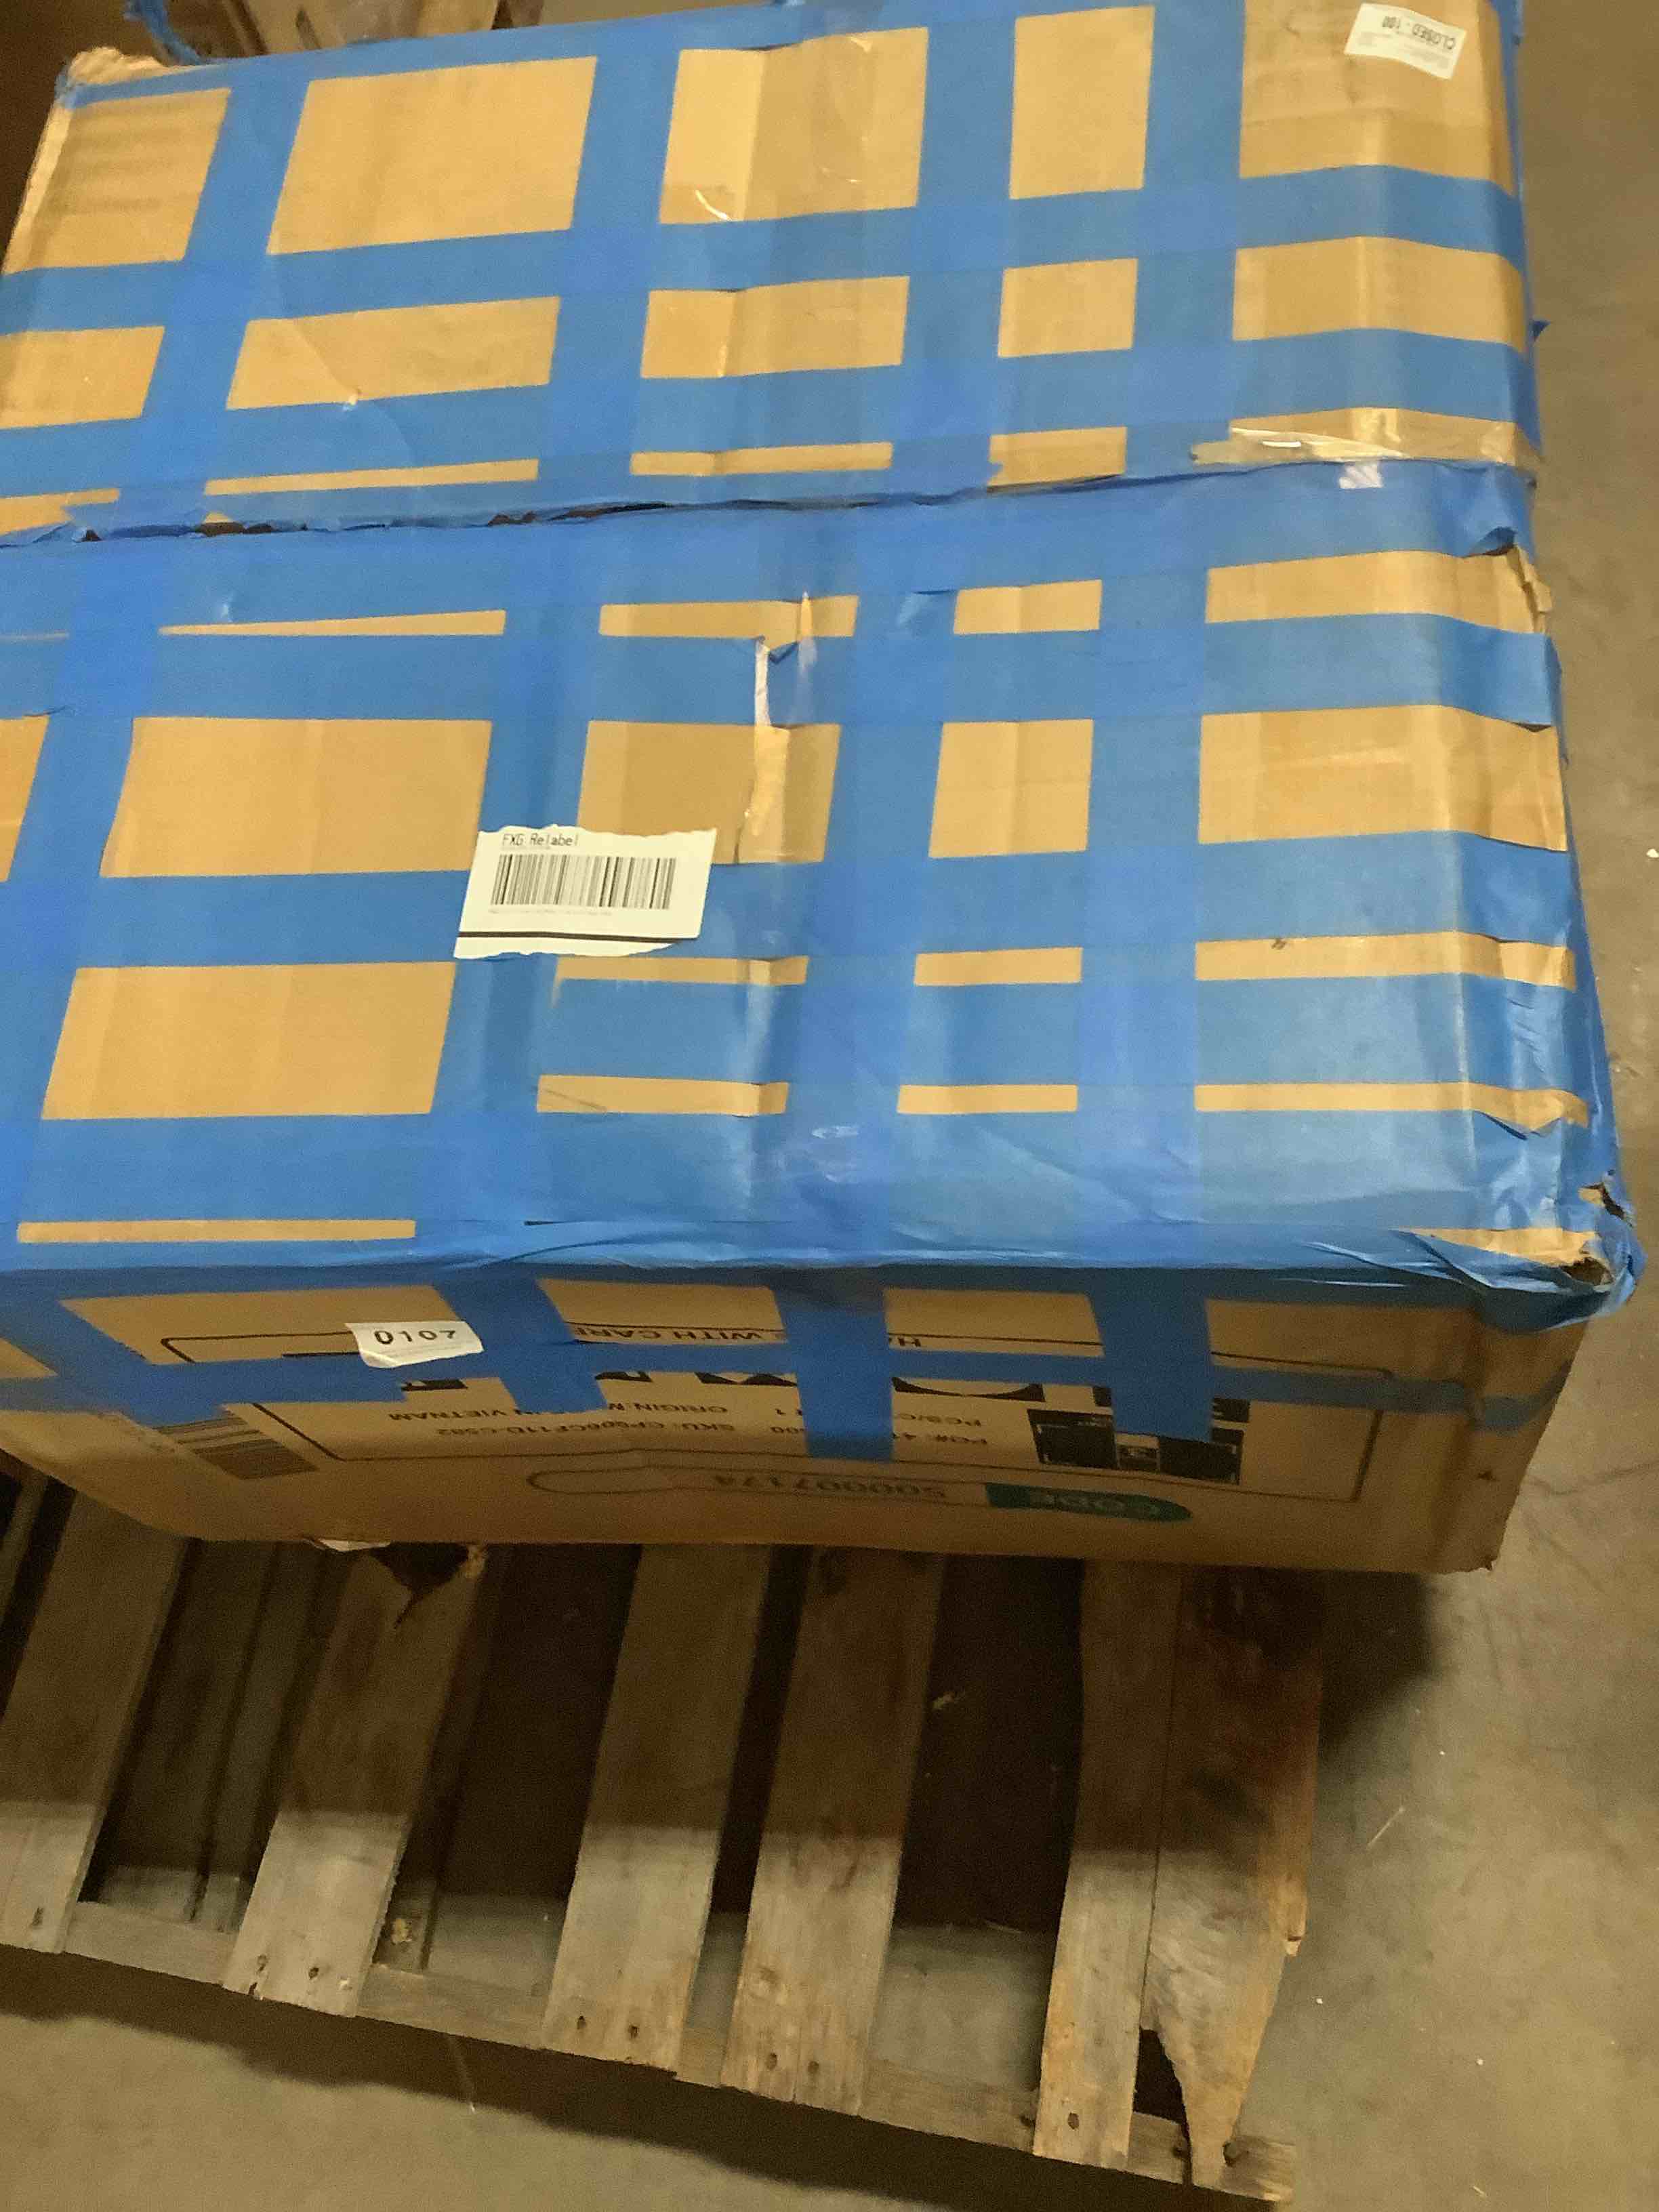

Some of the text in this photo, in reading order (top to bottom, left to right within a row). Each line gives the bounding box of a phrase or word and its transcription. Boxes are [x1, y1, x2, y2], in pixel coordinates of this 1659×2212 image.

[501, 833, 579, 847] FXG Relabel
[672, 1330, 763, 1340] WITH
[388, 1409, 508, 1420] VIETNAM
